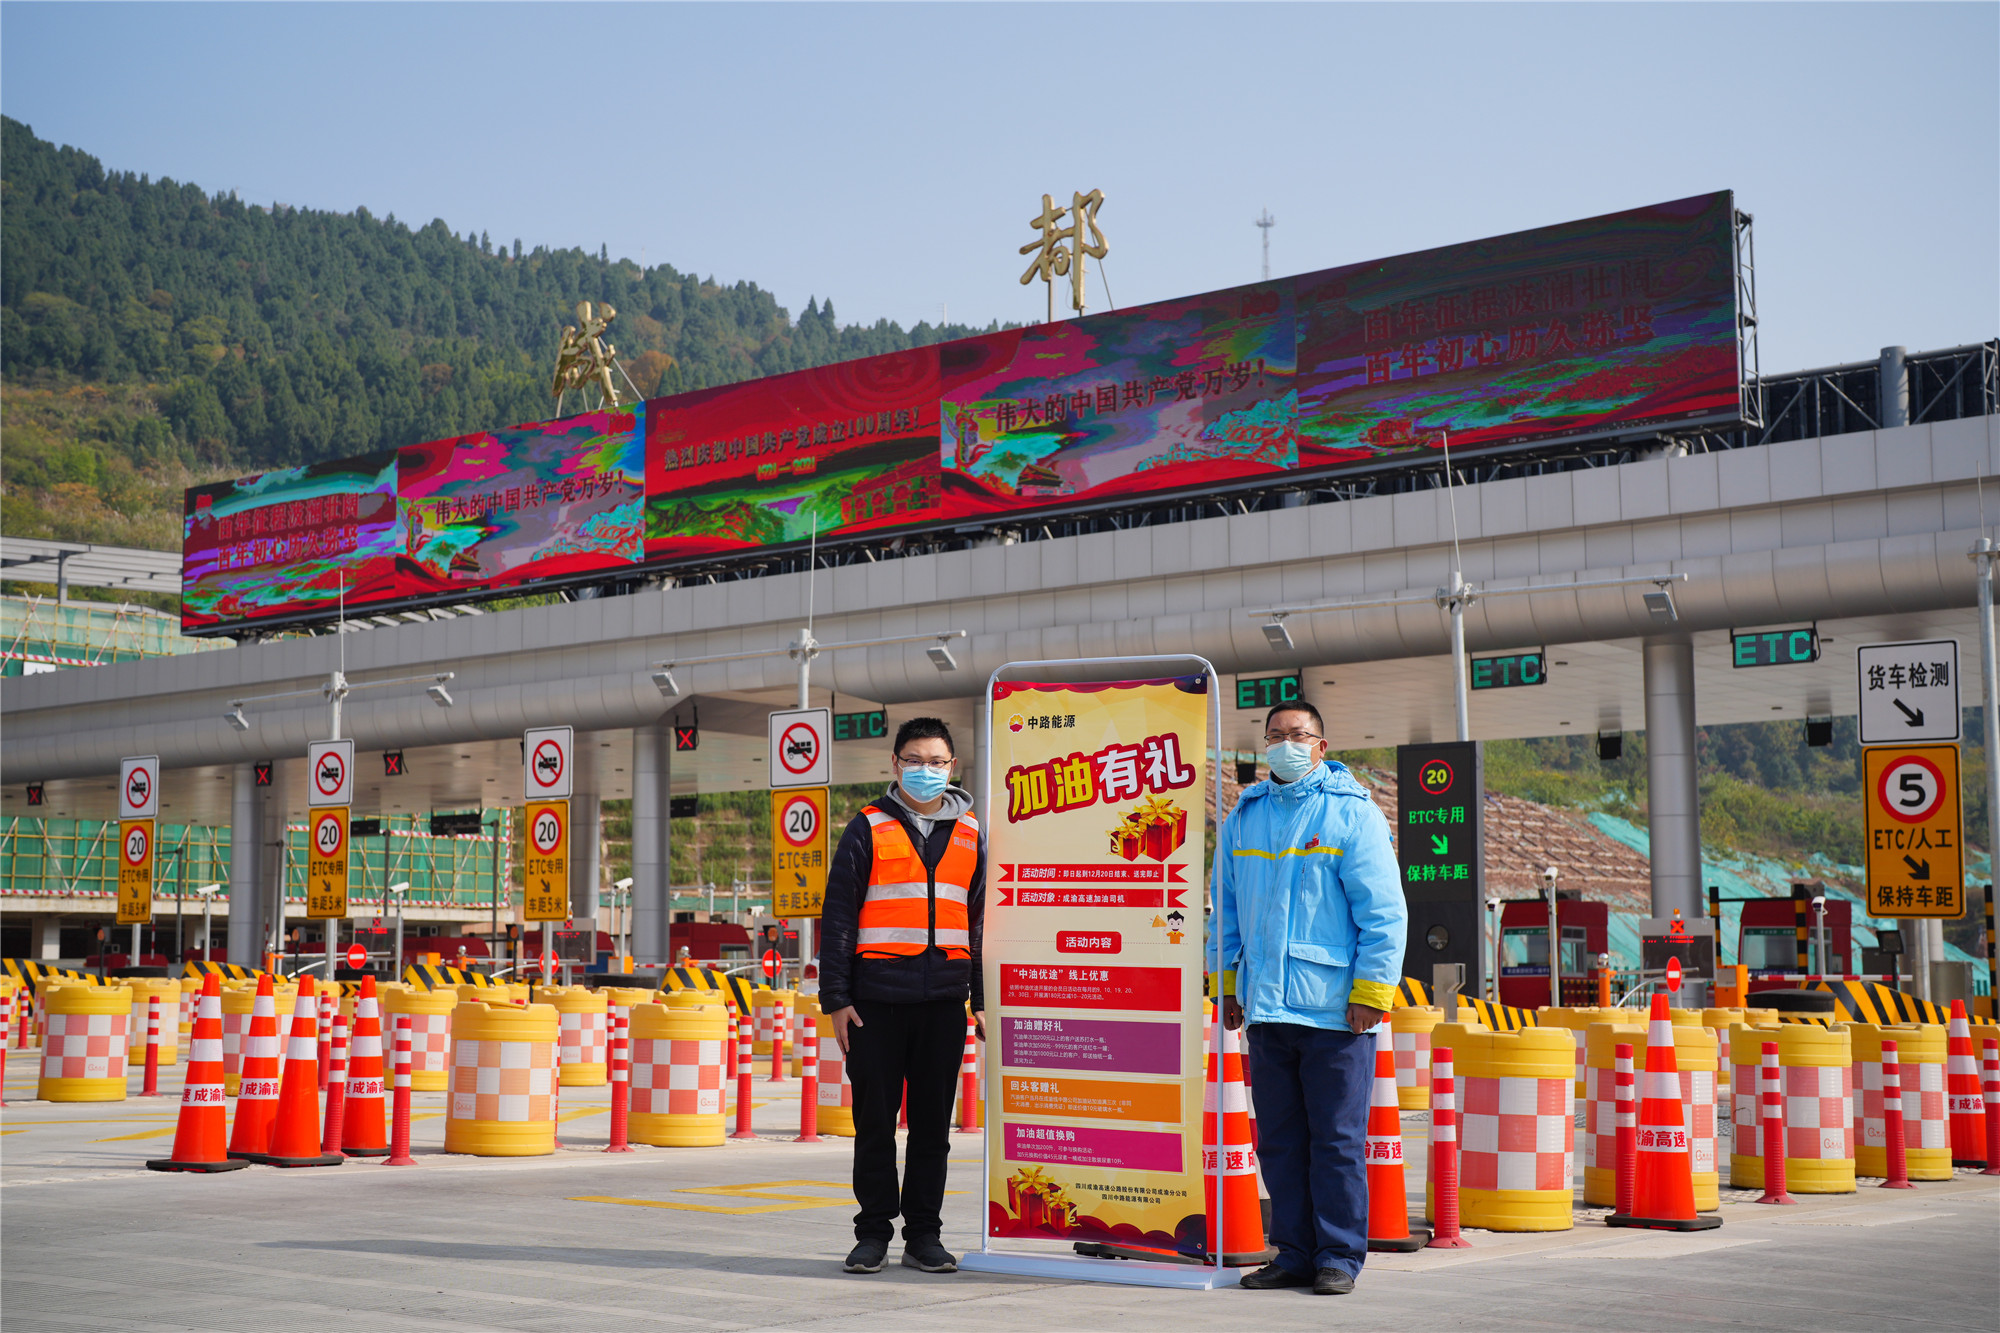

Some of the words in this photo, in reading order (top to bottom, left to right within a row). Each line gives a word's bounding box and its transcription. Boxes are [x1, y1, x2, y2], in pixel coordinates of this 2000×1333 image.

[1363, 304, 1656, 386] 百年初心历久弥坚
[217, 524, 359, 570] 百年初心历久弥坚
[1735, 631, 1811, 666] ETC
[1473, 655, 1540, 688] ETC
[1867, 661, 1949, 691] 货车检测
[1238, 677, 1298, 708] ETC
[835, 711, 883, 739] ETC
[1027, 714, 1076, 730] 中路能源
[1008, 736, 1191, 819] 加油有礼
[1427, 769, 1447, 785] 20
[1899, 773, 1926, 807] 5
[789, 809, 812, 833] 20
[1408, 806, 1465, 825] ETC专用
[320, 825, 337, 845] 20
[538, 821, 556, 842] 20
[1874, 828, 1953, 850] ETC/人工
[130, 836, 145, 855] 20
[778, 850, 822, 870] ETC专用
[1407, 864, 1469, 882] 保持车距
[528, 896, 563, 914] 车距5米
[778, 891, 822, 910] 车距5米
[1877, 885, 1954, 908] 保持车距
[1066, 936, 1112, 948] 活动内容
[1013, 1019, 1063, 1032] 加油赠好礼
[1010, 1080, 1060, 1093] 回头客赠礼
[1016, 1127, 1075, 1142] 加油超值换购
